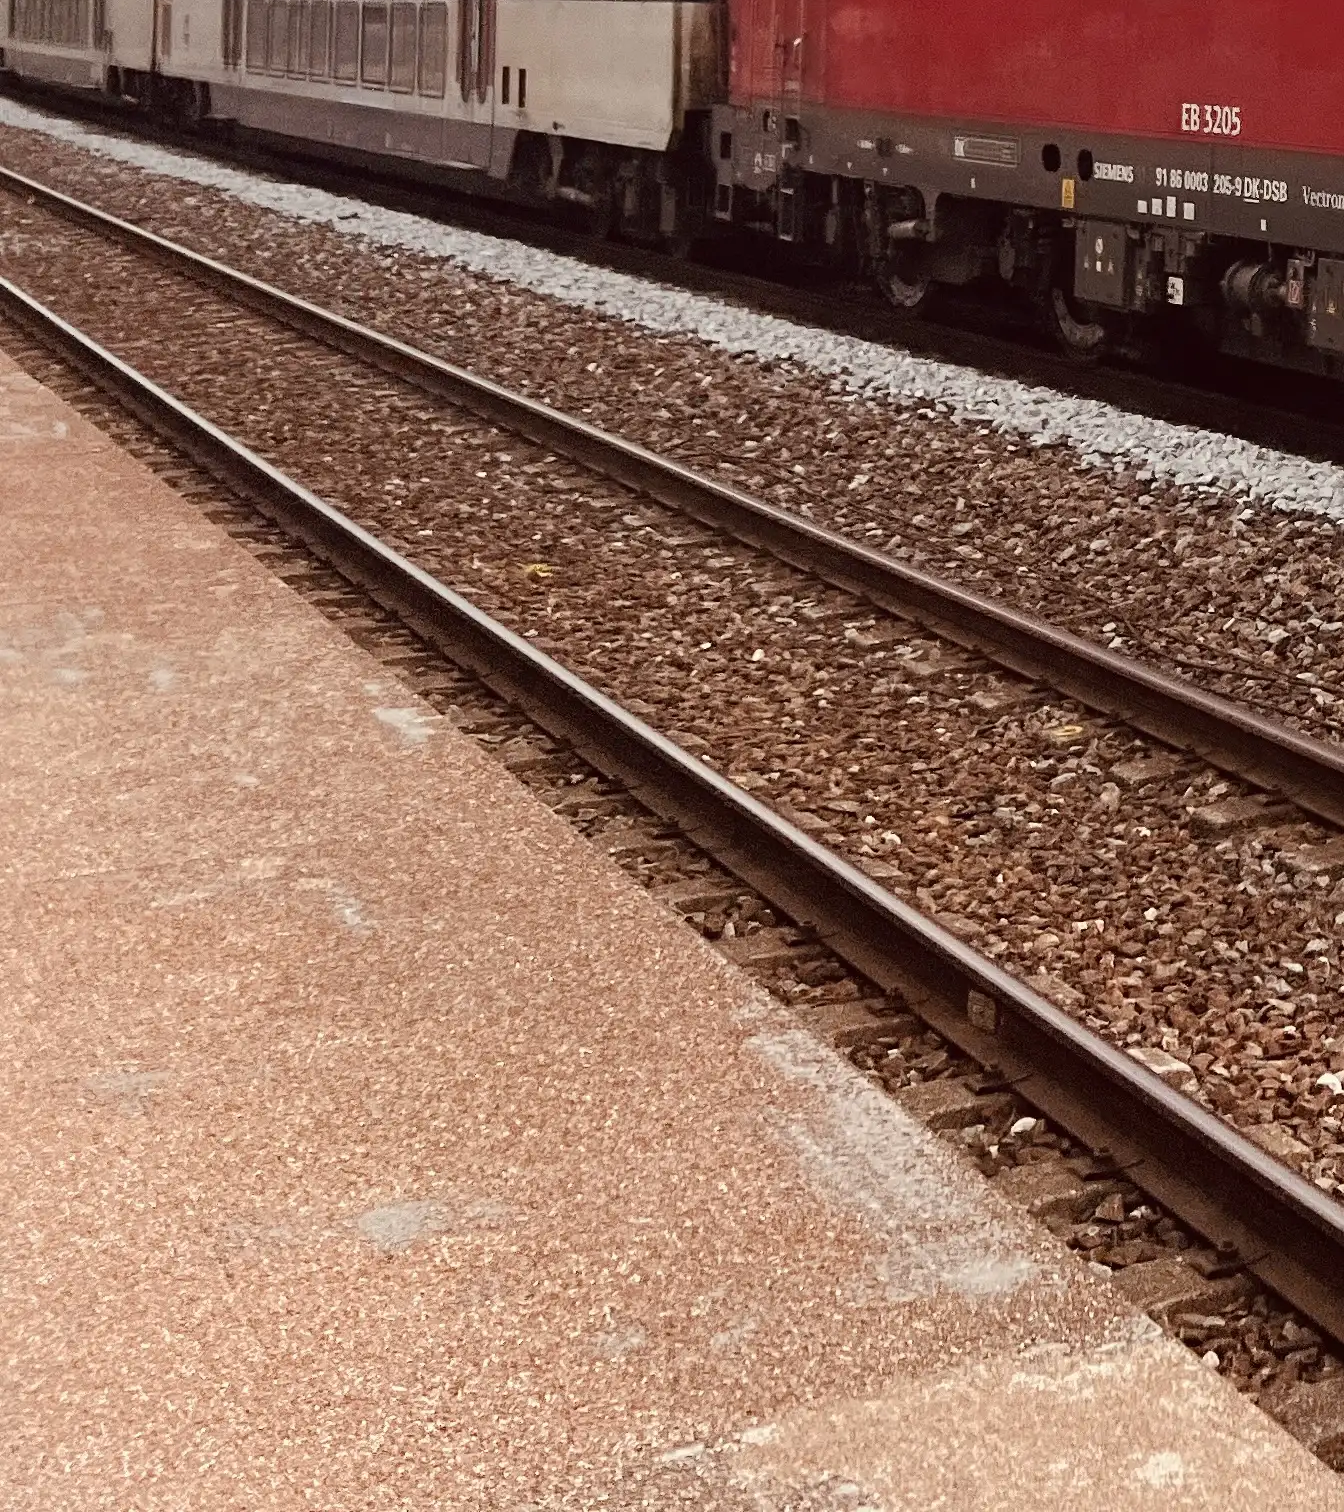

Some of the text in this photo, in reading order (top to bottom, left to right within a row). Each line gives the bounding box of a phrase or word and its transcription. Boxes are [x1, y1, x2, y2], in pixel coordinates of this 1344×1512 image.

[1181, 102, 1241, 136] EB 3205
[1093, 161, 1134, 183] SIEMENS
[1155, 167, 1167, 187] 91
[1169, 169, 1182, 189] 86
[1184, 171, 1209, 192] 0003
[1213, 174, 1242, 197] 205-9
